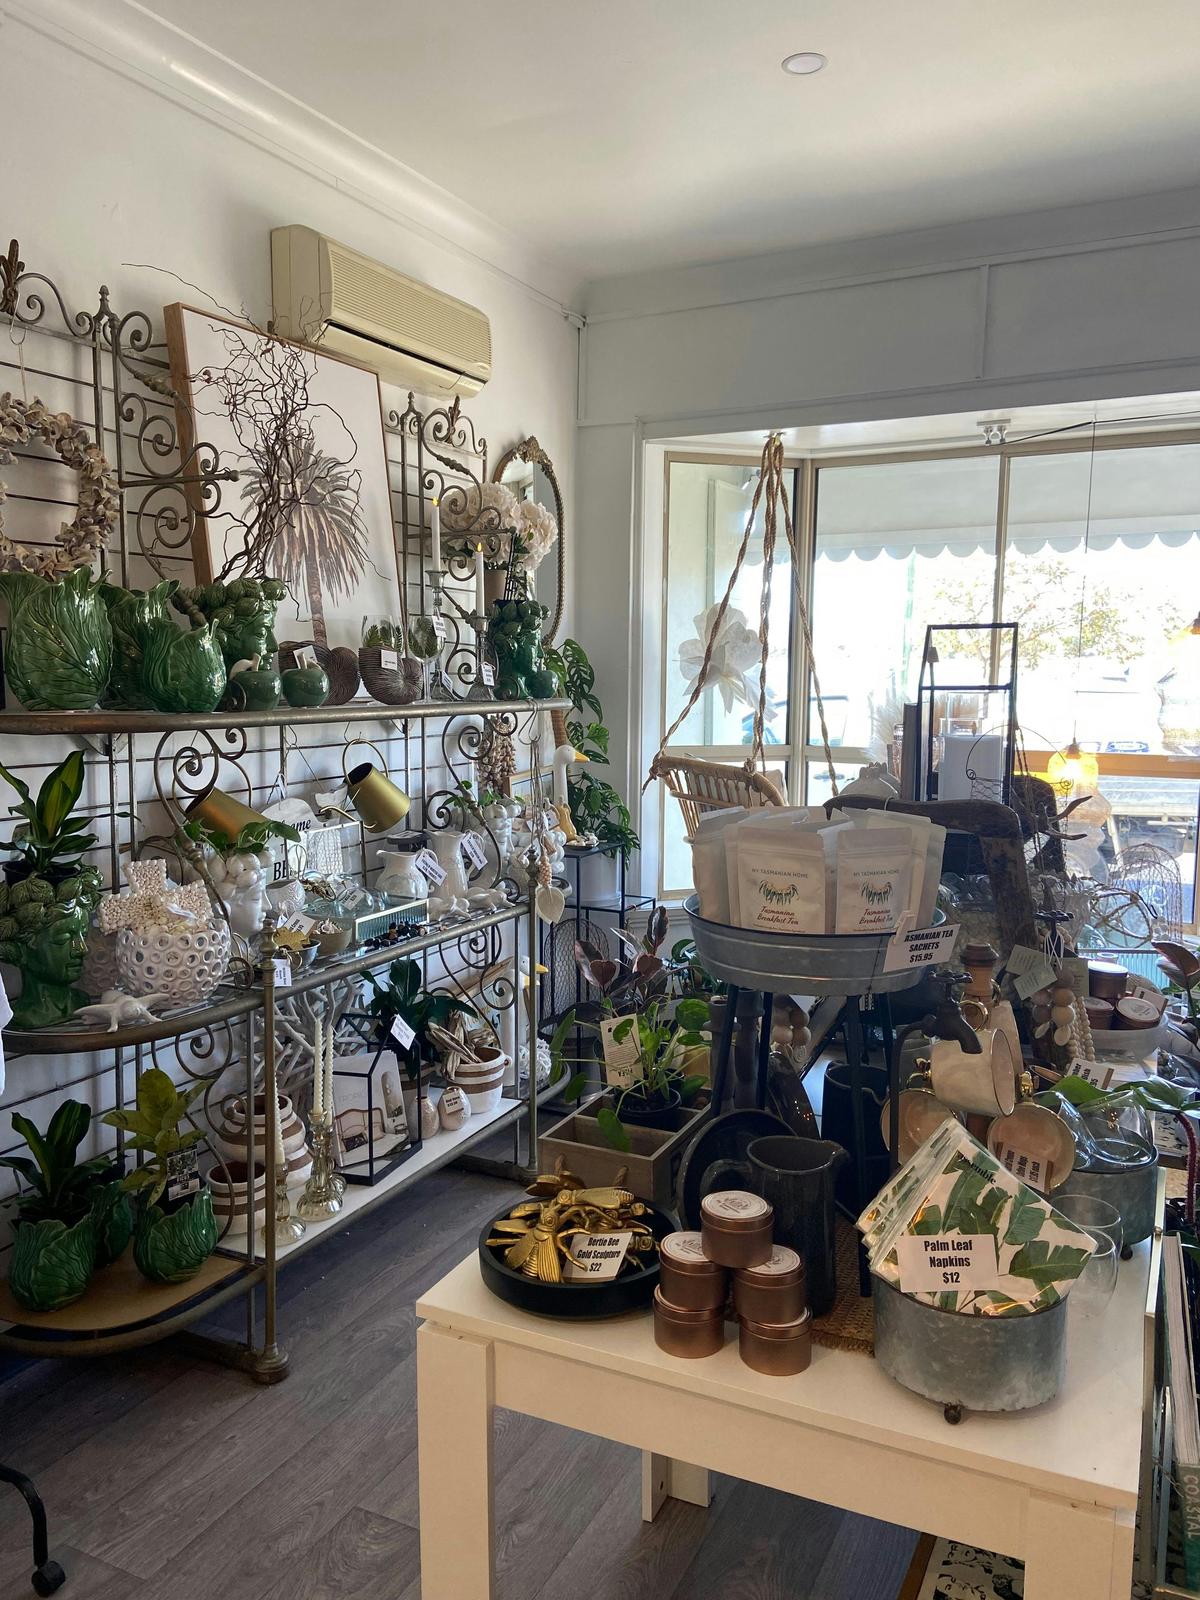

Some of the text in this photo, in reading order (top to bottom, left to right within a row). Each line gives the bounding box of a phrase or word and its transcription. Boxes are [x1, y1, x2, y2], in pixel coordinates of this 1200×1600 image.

[760, 868, 793, 877] TASMANIAN
[761, 905, 795, 917] Tasmanian
[757, 914, 799, 925] Breakfast Tea
[904, 929, 954, 943] ASMANIAN TEA
[909, 942, 940, 953] SACHETS
[909, 952, 934, 963] $15.95
[587, 1237, 620, 1247] Bertie Bee
[924, 1239, 973, 1252] Palm Leaf
[577, 1249, 621, 1260] Gold Sculpture
[589, 1262, 602, 1272] $22
[929, 1255, 971, 1269] Napkins
[943, 1271, 961, 1284] $12
[1183, 1475, 1200, 1539] COASTAL
